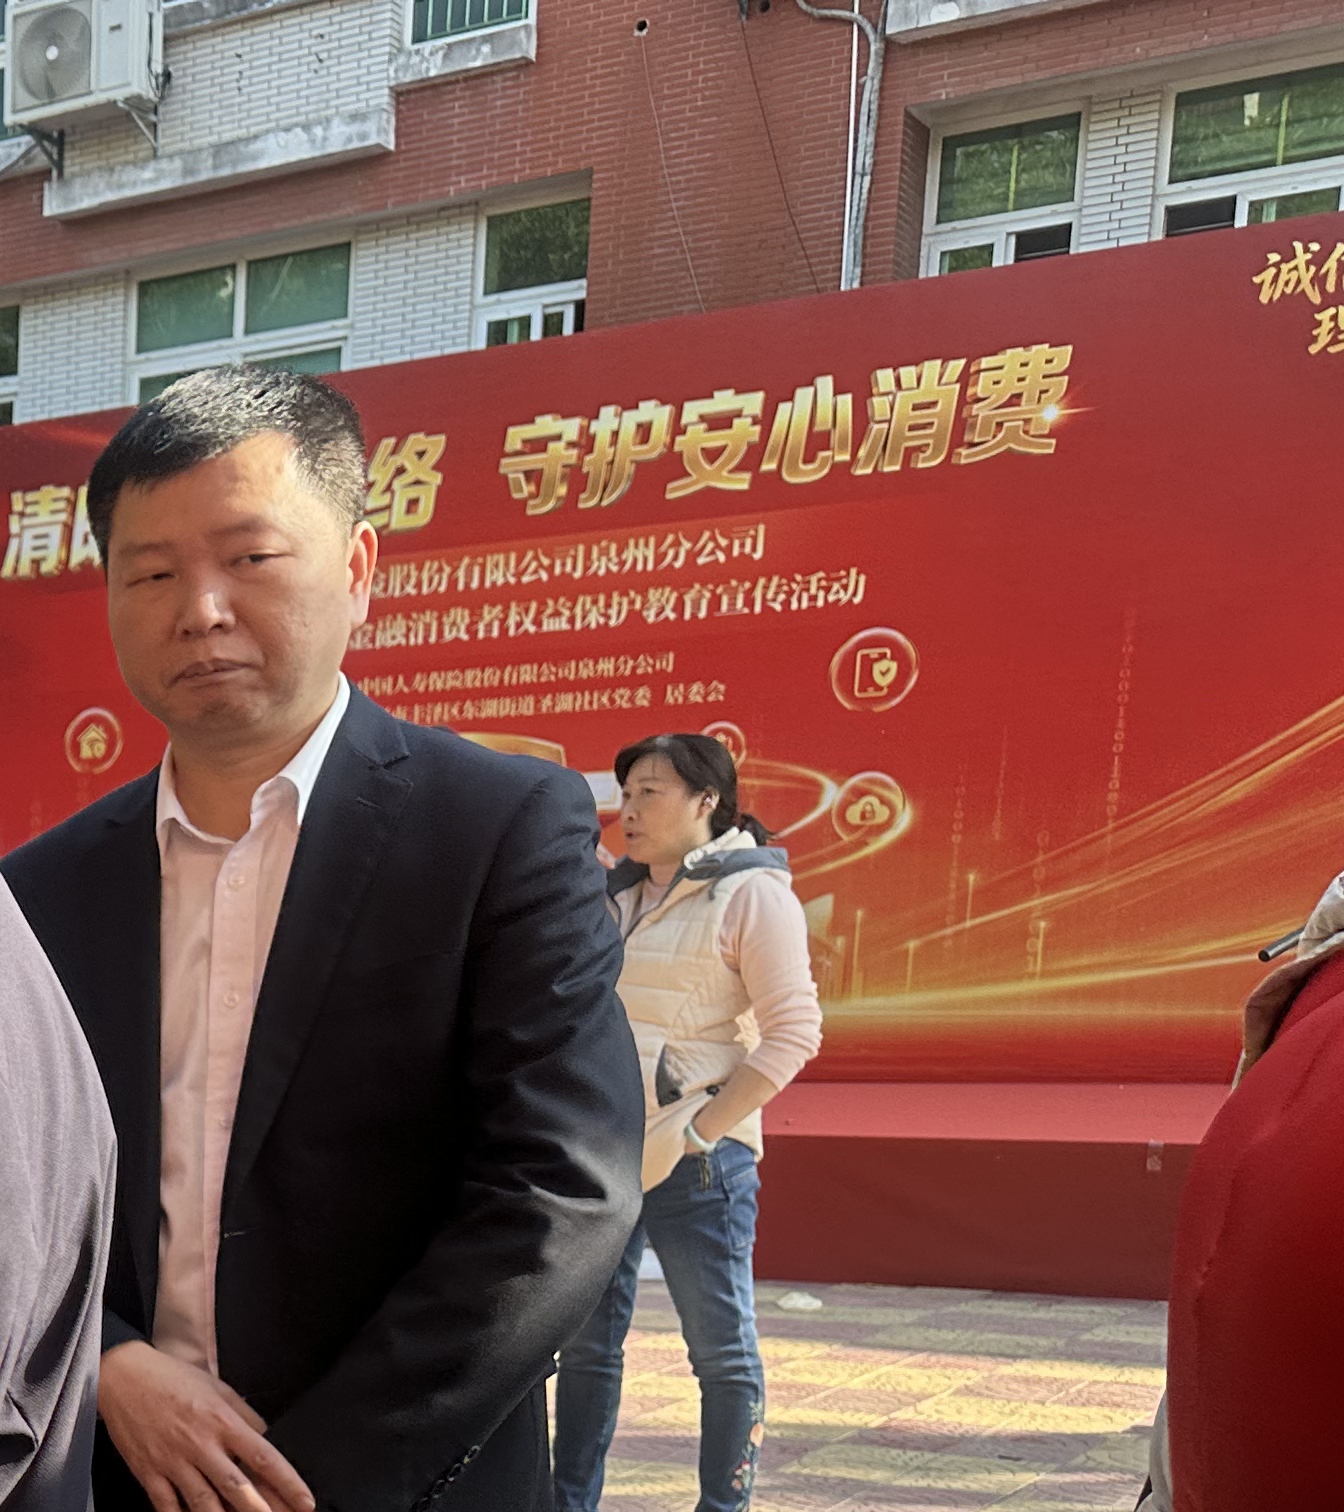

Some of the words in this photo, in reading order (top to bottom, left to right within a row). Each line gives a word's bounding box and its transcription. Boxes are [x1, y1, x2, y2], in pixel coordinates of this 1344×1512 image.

[499, 343, 1074, 517] 守护安心消费
